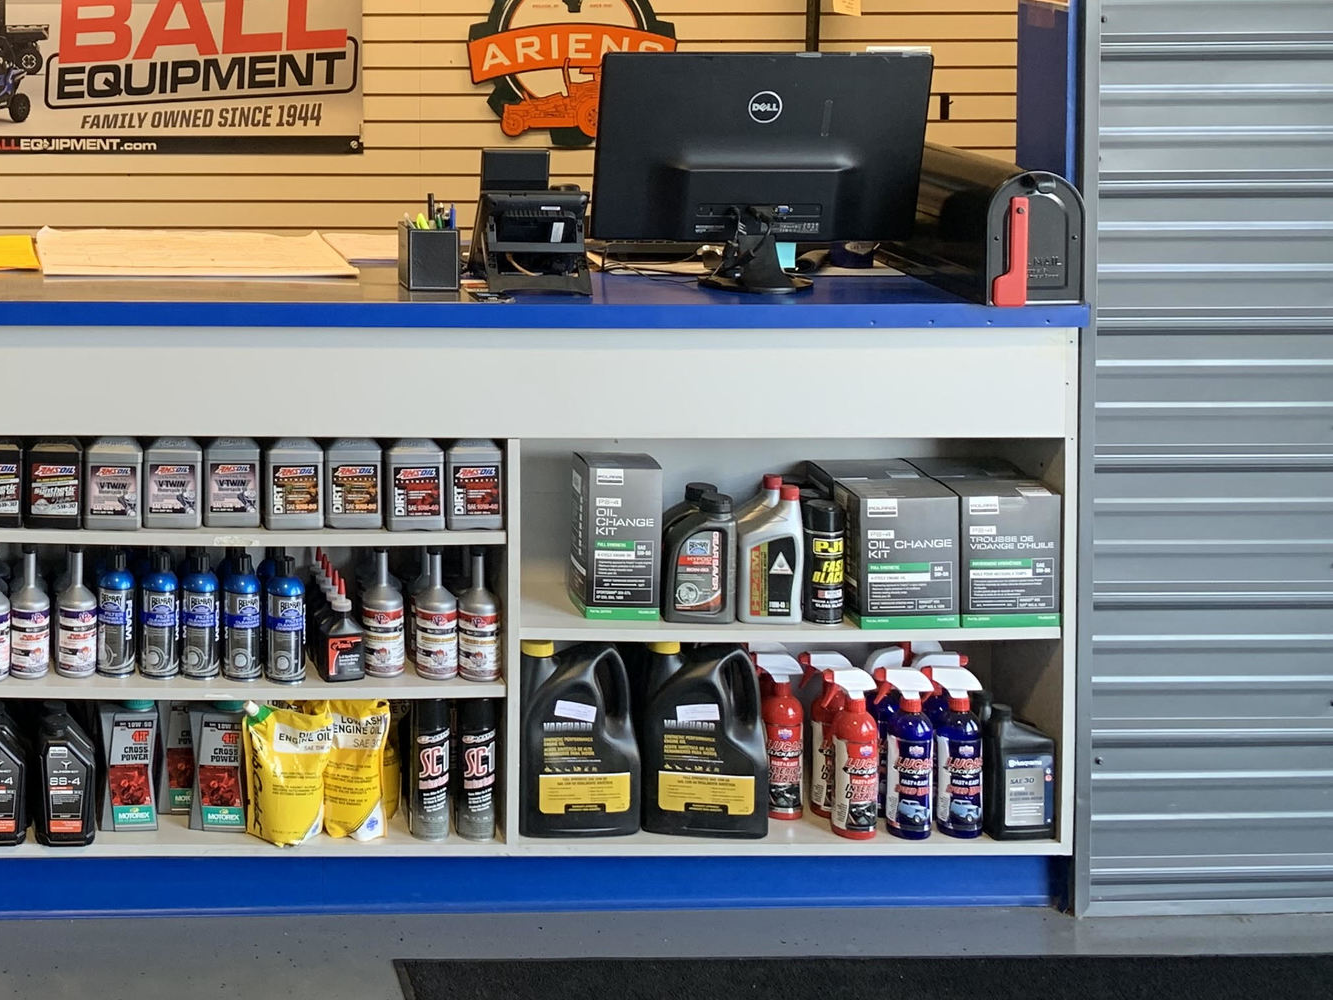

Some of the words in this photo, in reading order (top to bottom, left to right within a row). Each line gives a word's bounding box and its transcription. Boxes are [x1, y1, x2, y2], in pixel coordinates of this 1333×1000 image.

[57, 51, 346, 99] EQUIPMENT
[752, 103, 778, 111] DELL
[80, 112, 149, 129] FAMILY
[151, 109, 214, 127] OWNED
[217, 105, 273, 127] SINCE
[277, 103, 322, 126] 1944
[39, 466, 75, 475] AMSOIL
[274, 485, 283, 513] DIRT
[333, 485, 342, 513] DIRT
[395, 487, 404, 515] DIRT
[596, 508, 617, 516] OIL
[596, 518, 654, 527] CHANGE
[596, 527, 617, 536] KIT
[816, 540, 843, 553] PJ1
[868, 541, 890, 549] OIL
[894, 539, 952, 548] CHANGE
[334, 724, 367, 735] ENGINE
[370, 726, 381, 734] OIL
[317, 732, 331, 741] OIL
[354, 739, 370, 747] SAE
[1009, 759, 1042, 768] Husqvarna
[50, 777, 81, 785] SS-4
